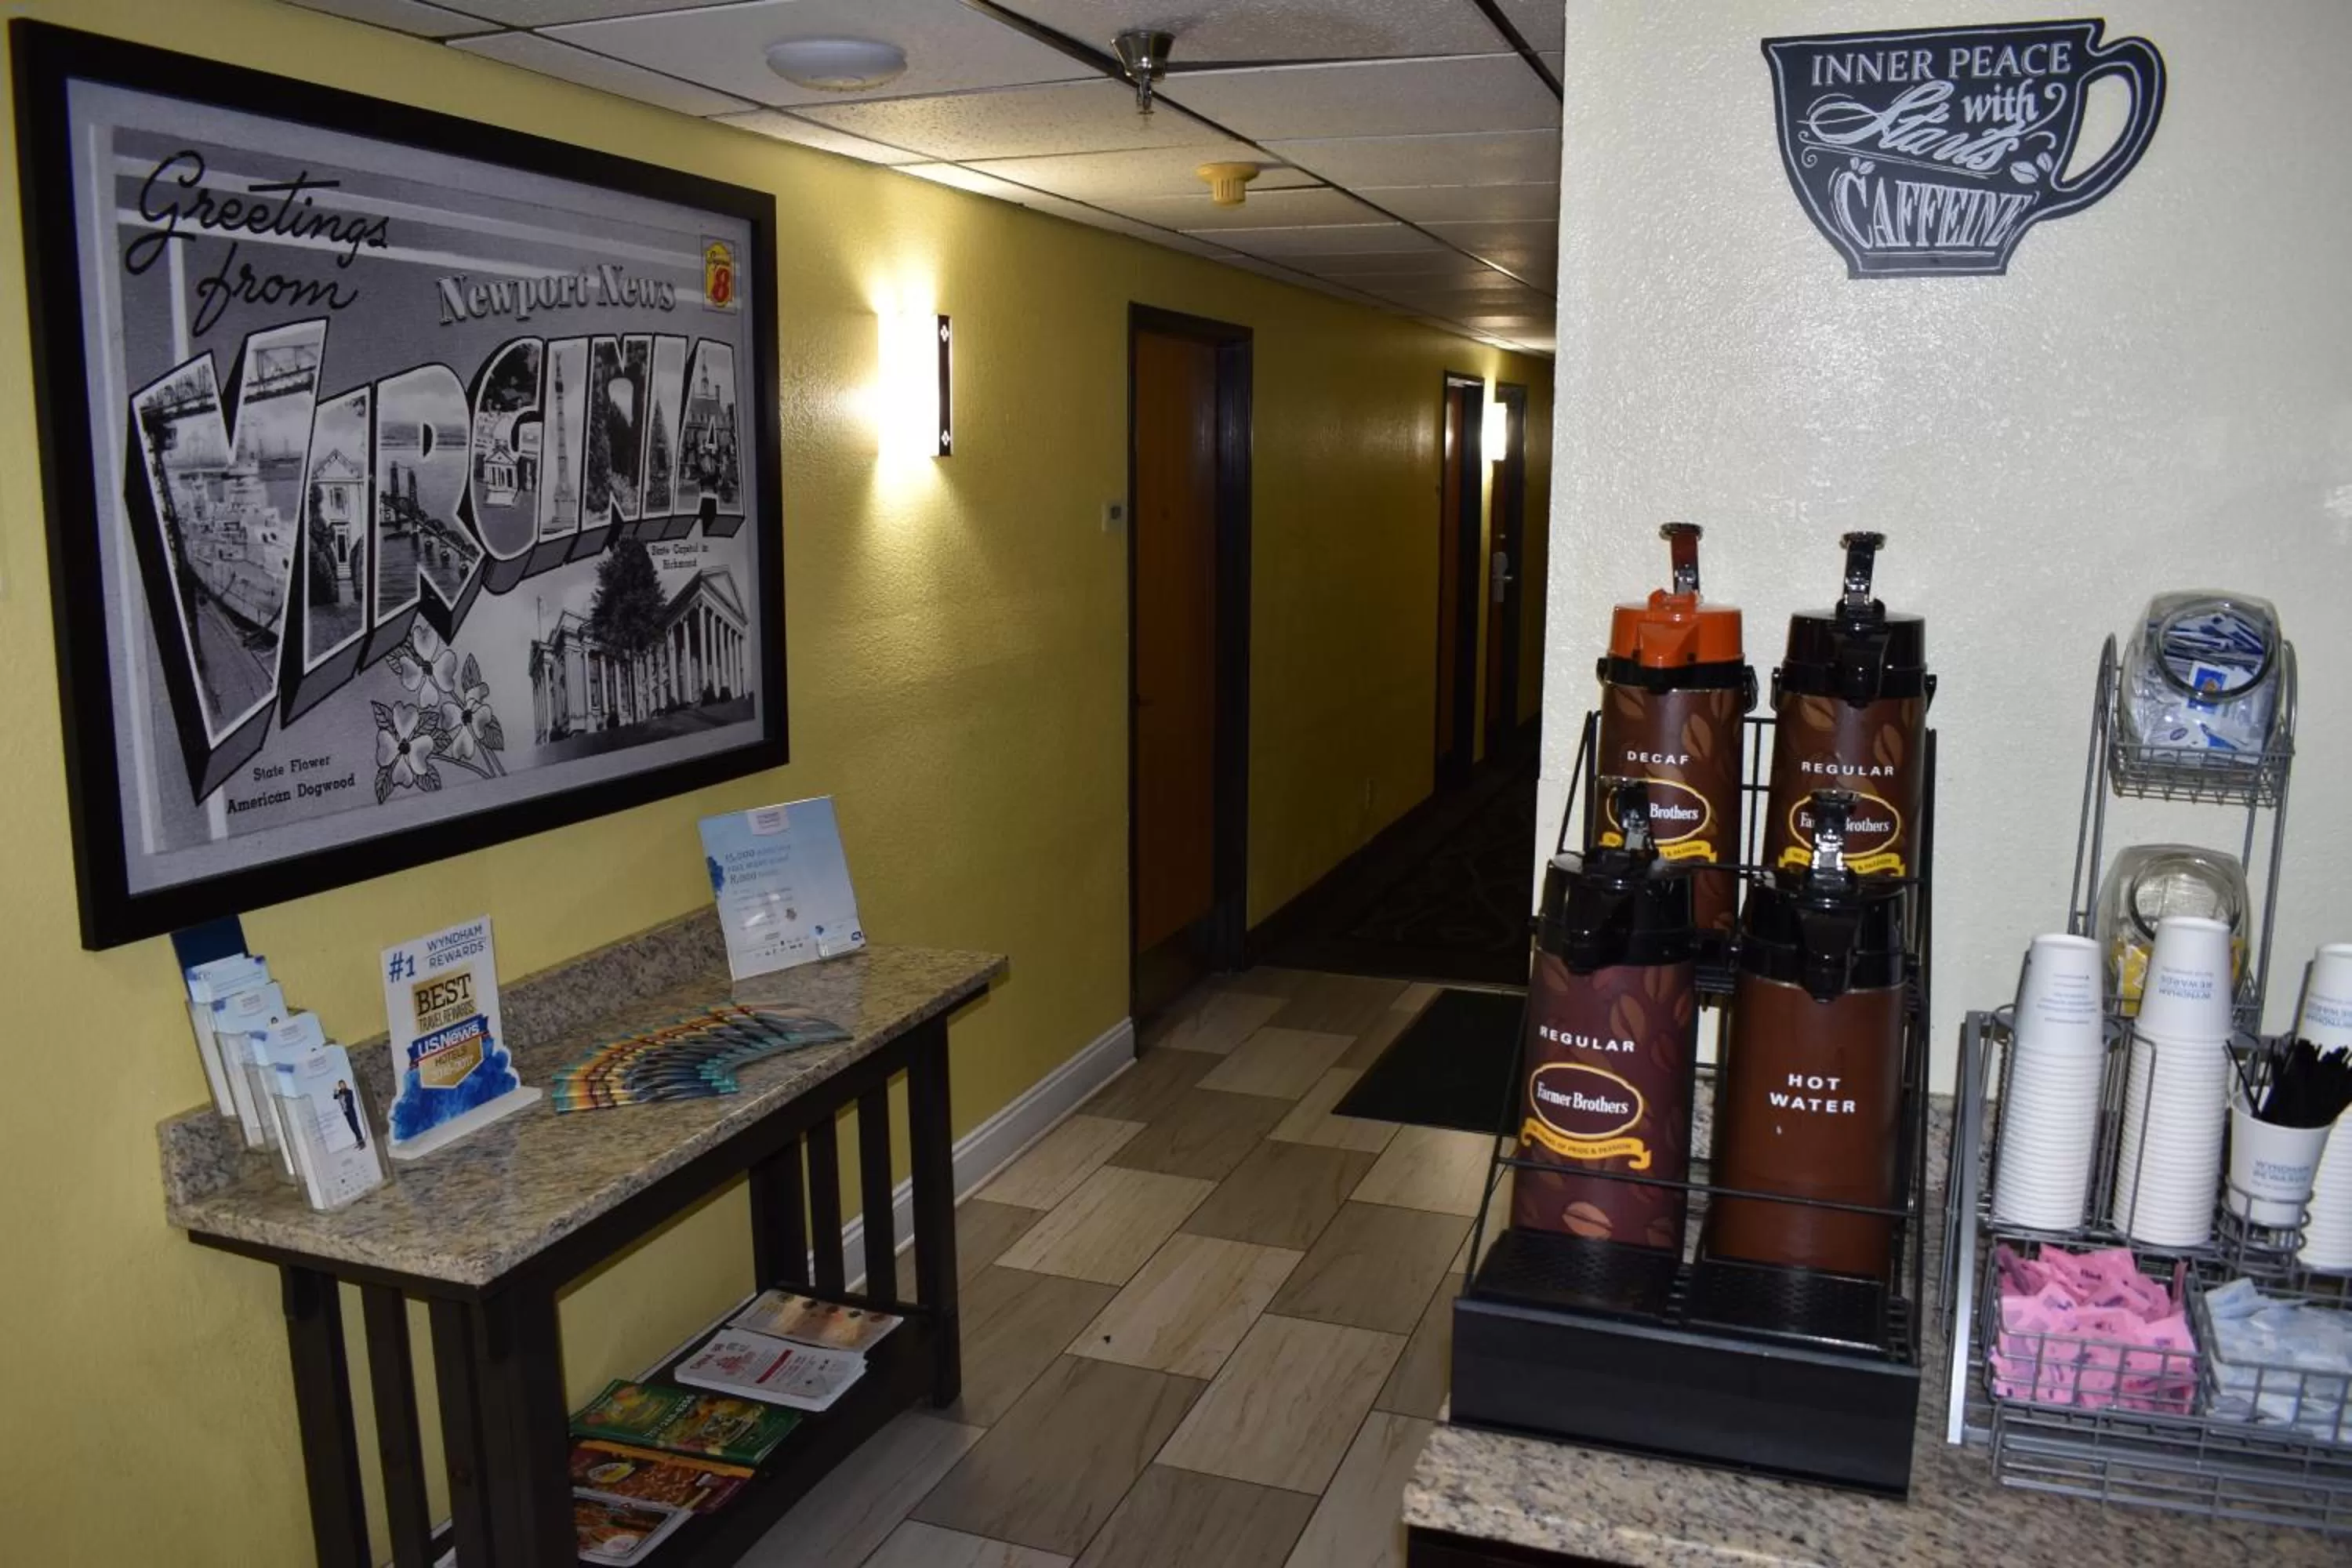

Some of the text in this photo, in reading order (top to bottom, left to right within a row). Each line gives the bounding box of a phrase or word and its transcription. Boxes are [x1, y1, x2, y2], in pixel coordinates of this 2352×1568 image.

[1811, 41, 2073, 86] INNER PEACE
[1961, 78, 2040, 132] with
[125, 150, 389, 275] Greetings
[1831, 170, 2038, 250] CAFFEINE
[192, 242, 358, 337] from
[438, 262, 677, 325] Newport News
[713, 267, 730, 303] 8
[125, 317, 746, 804] VIRGINIA
[253, 755, 331, 782] State Flower
[1627, 750, 1690, 765] DECAF
[1801, 760, 1895, 777] REGULAR
[227, 772, 355, 815] American Dogwood
[1650, 802, 1699, 820] Brothers
[426, 924, 483, 952] WYNDHAM
[389, 950, 416, 983] #1
[429, 942, 484, 969] REWARDS
[415, 972, 472, 1016] BEST
[1538, 1025, 1636, 1053] REGULAR
[1537, 1081, 1629, 1114] Farmer Brothers
[1788, 1073, 1842, 1092] HOT
[1769, 1091, 1856, 1114] WATER
